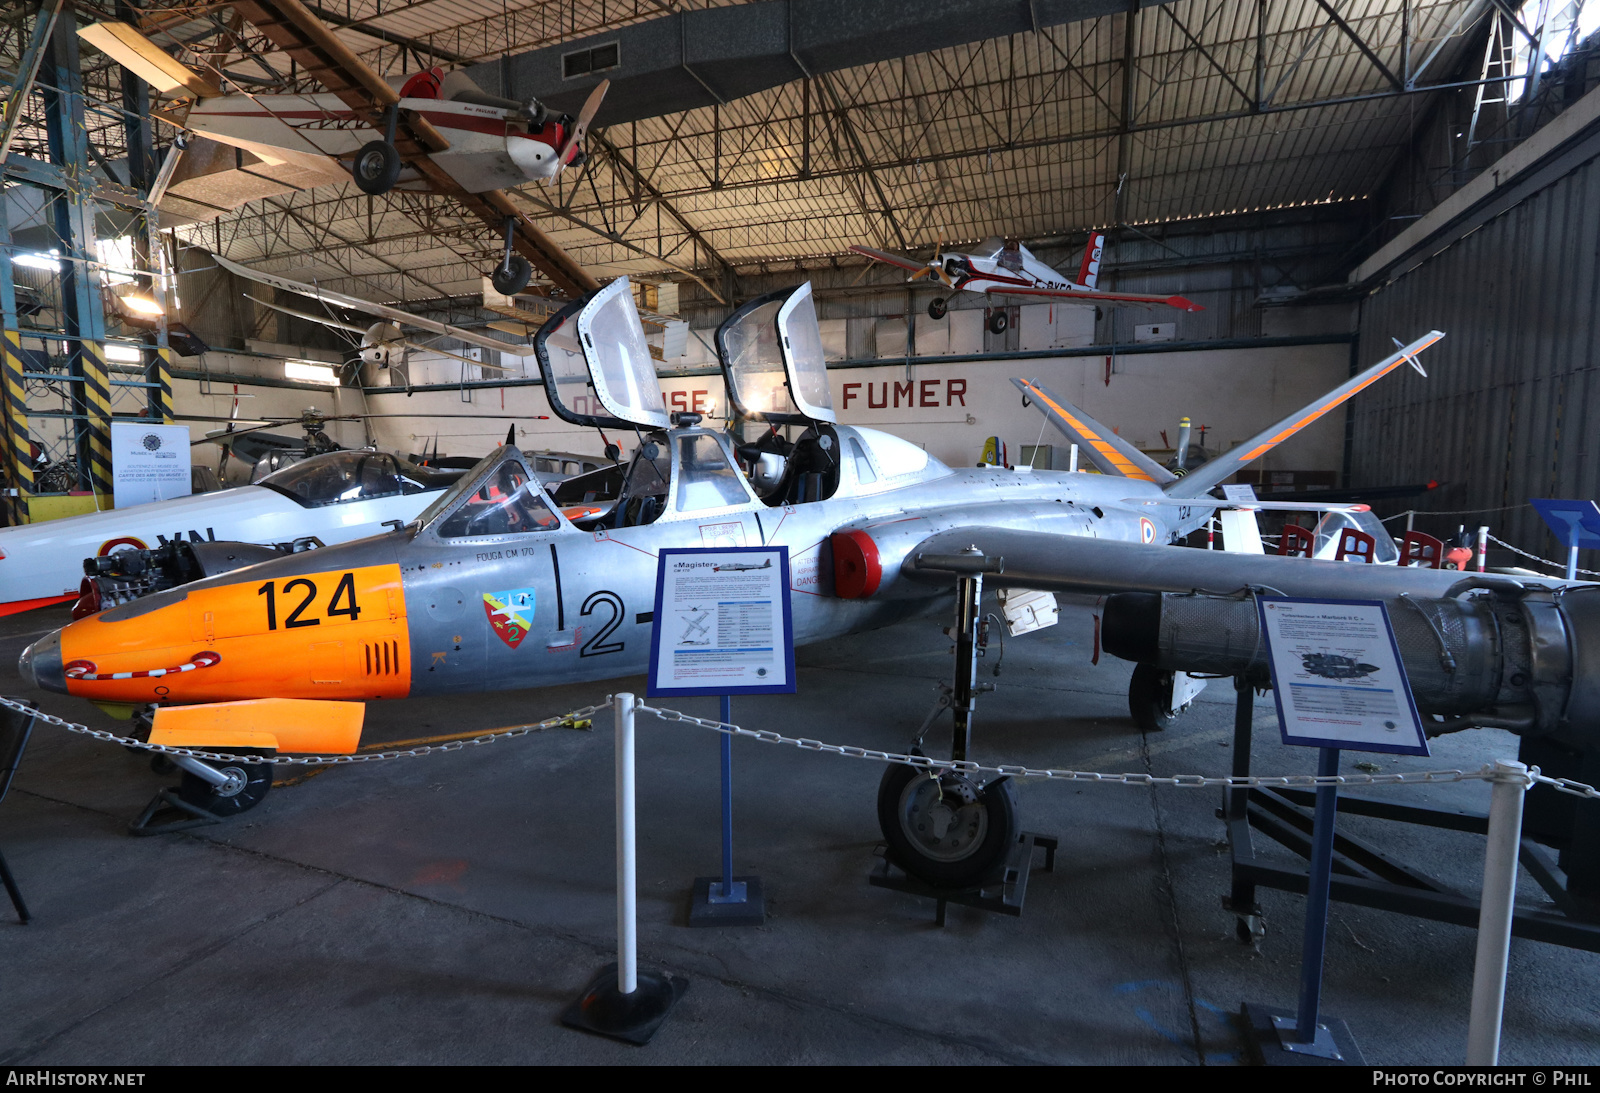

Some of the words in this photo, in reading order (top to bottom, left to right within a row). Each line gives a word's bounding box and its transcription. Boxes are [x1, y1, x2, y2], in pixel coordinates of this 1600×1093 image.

[843, 379, 967, 410] FUMER
[1179, 505, 1191, 520] 124
[476, 551, 503, 562] FOUGA
[505, 549, 519, 559] CM
[521, 547, 535, 556] 170
[258, 573, 361, 631] 124
[507, 626, 520, 642] 2
